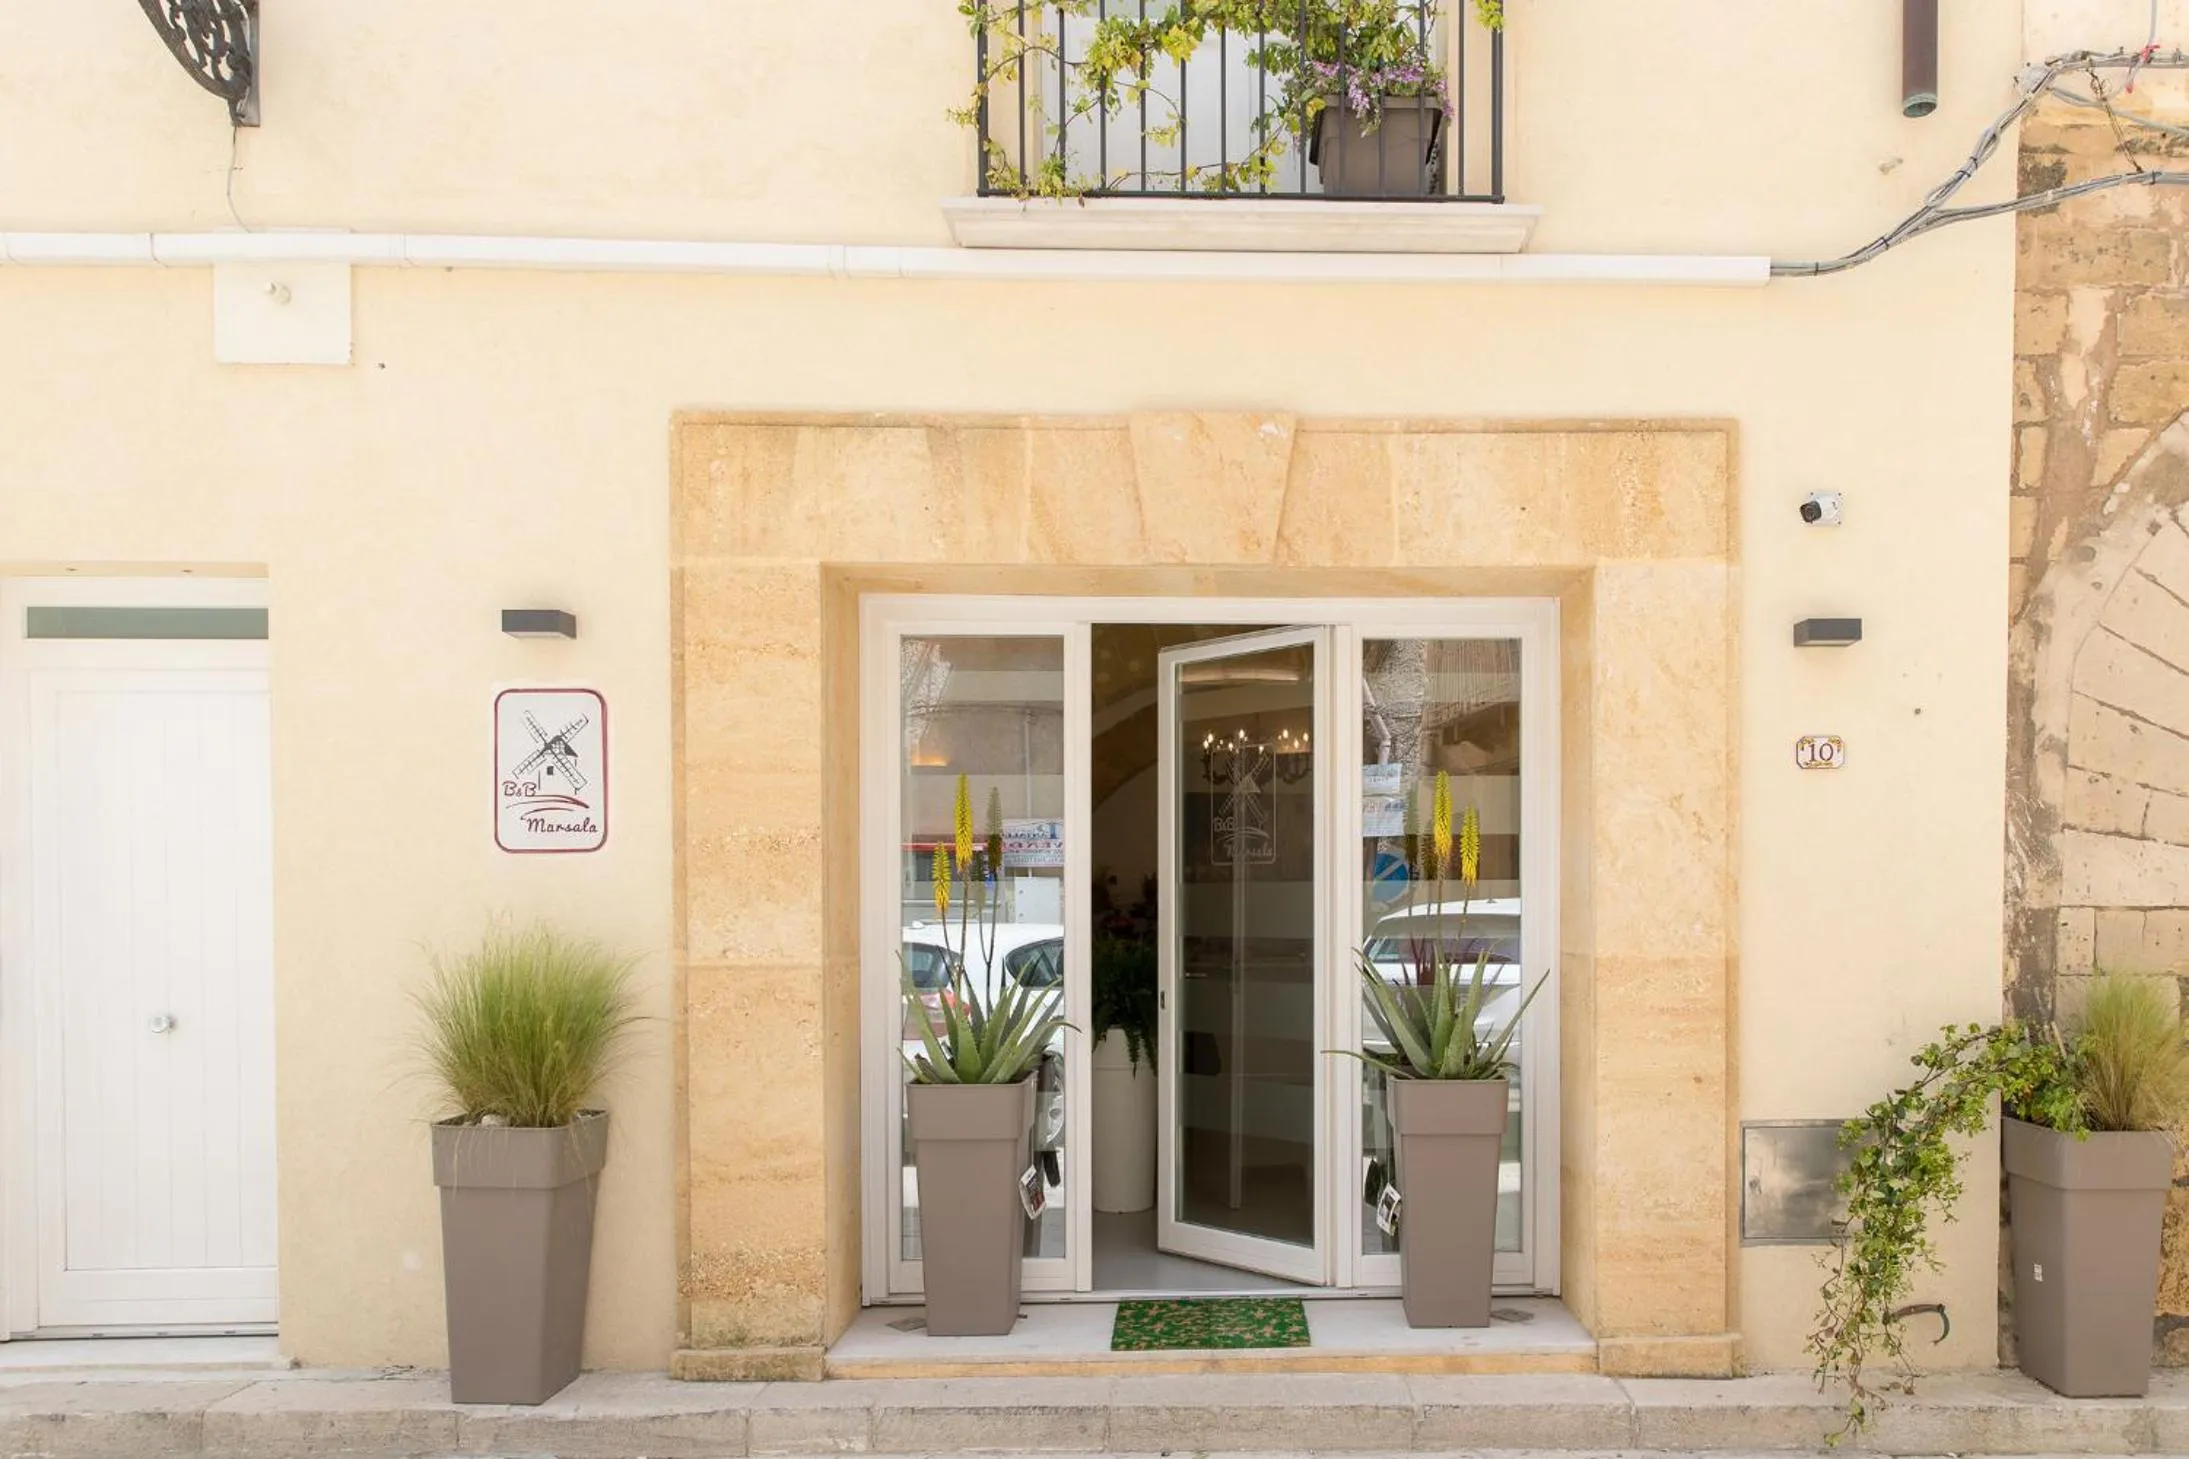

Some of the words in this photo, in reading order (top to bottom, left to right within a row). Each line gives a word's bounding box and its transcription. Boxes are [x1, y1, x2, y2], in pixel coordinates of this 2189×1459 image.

[1808, 743, 1834, 762] 10
[502, 781, 537, 798] B&B
[525, 817, 599, 834] Marsala
